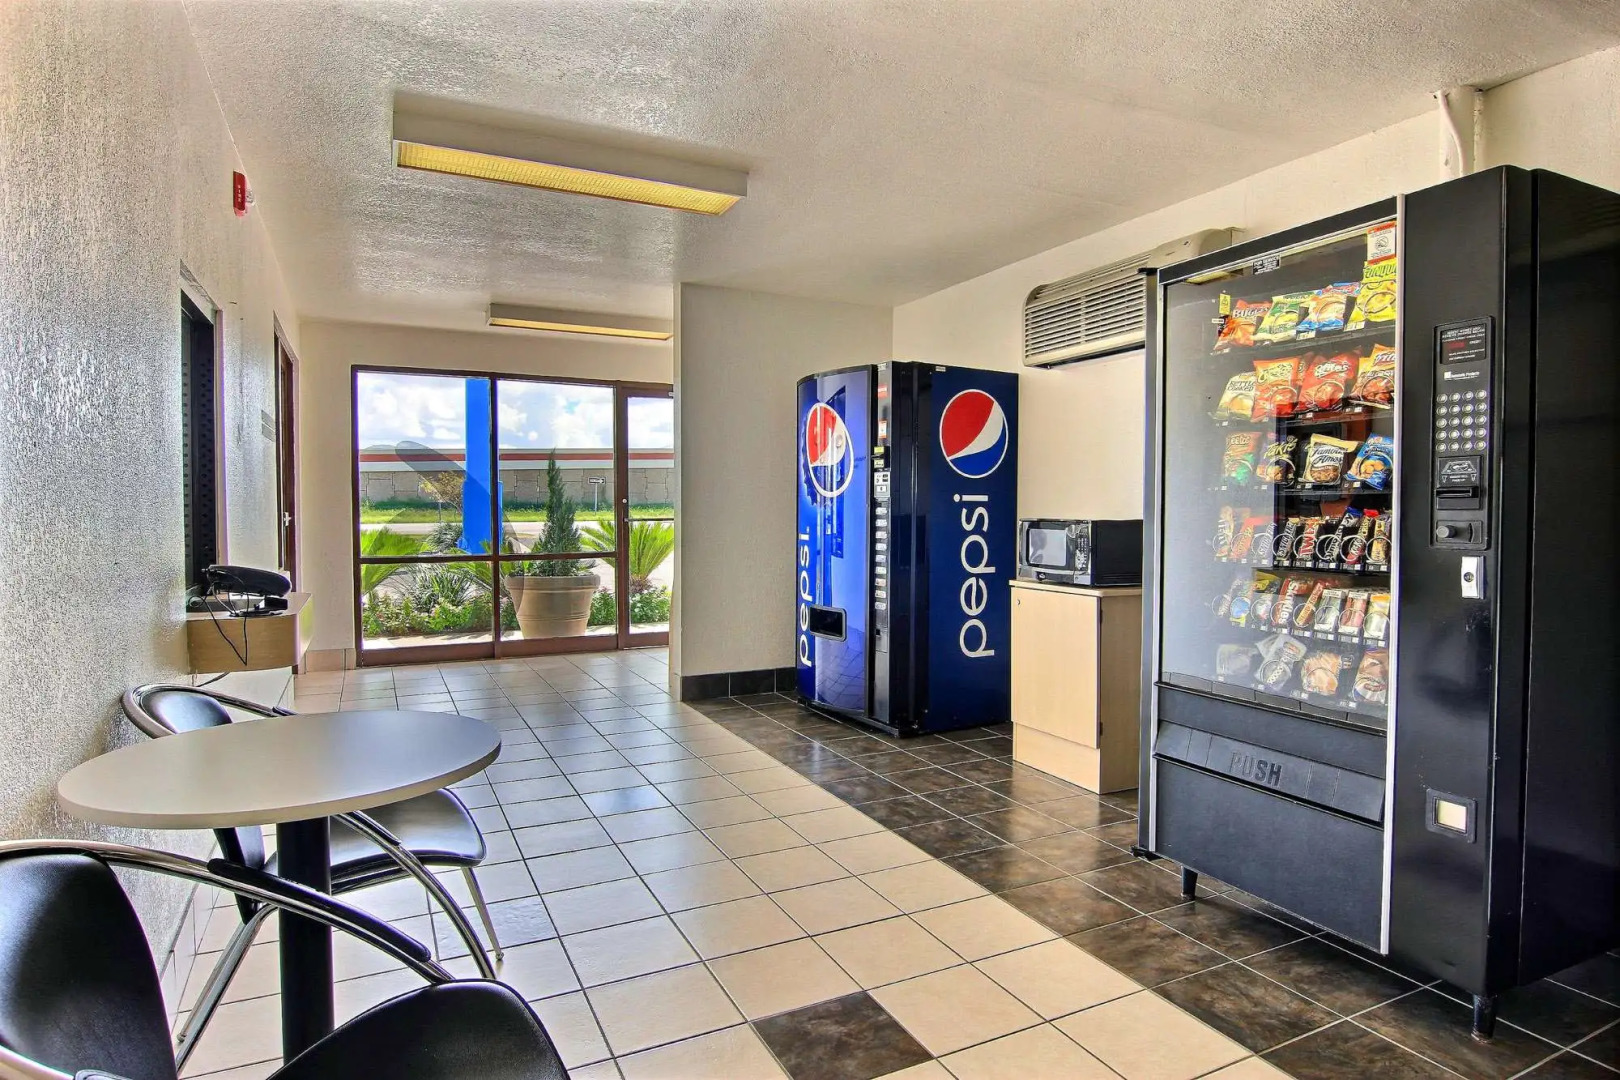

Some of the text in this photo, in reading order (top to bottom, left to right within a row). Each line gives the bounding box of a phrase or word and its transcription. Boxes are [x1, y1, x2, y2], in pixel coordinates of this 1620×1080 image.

[799, 526, 813, 668] pepsi
[953, 493, 996, 658] pepsi
[1229, 752, 1282, 787] PUSH
